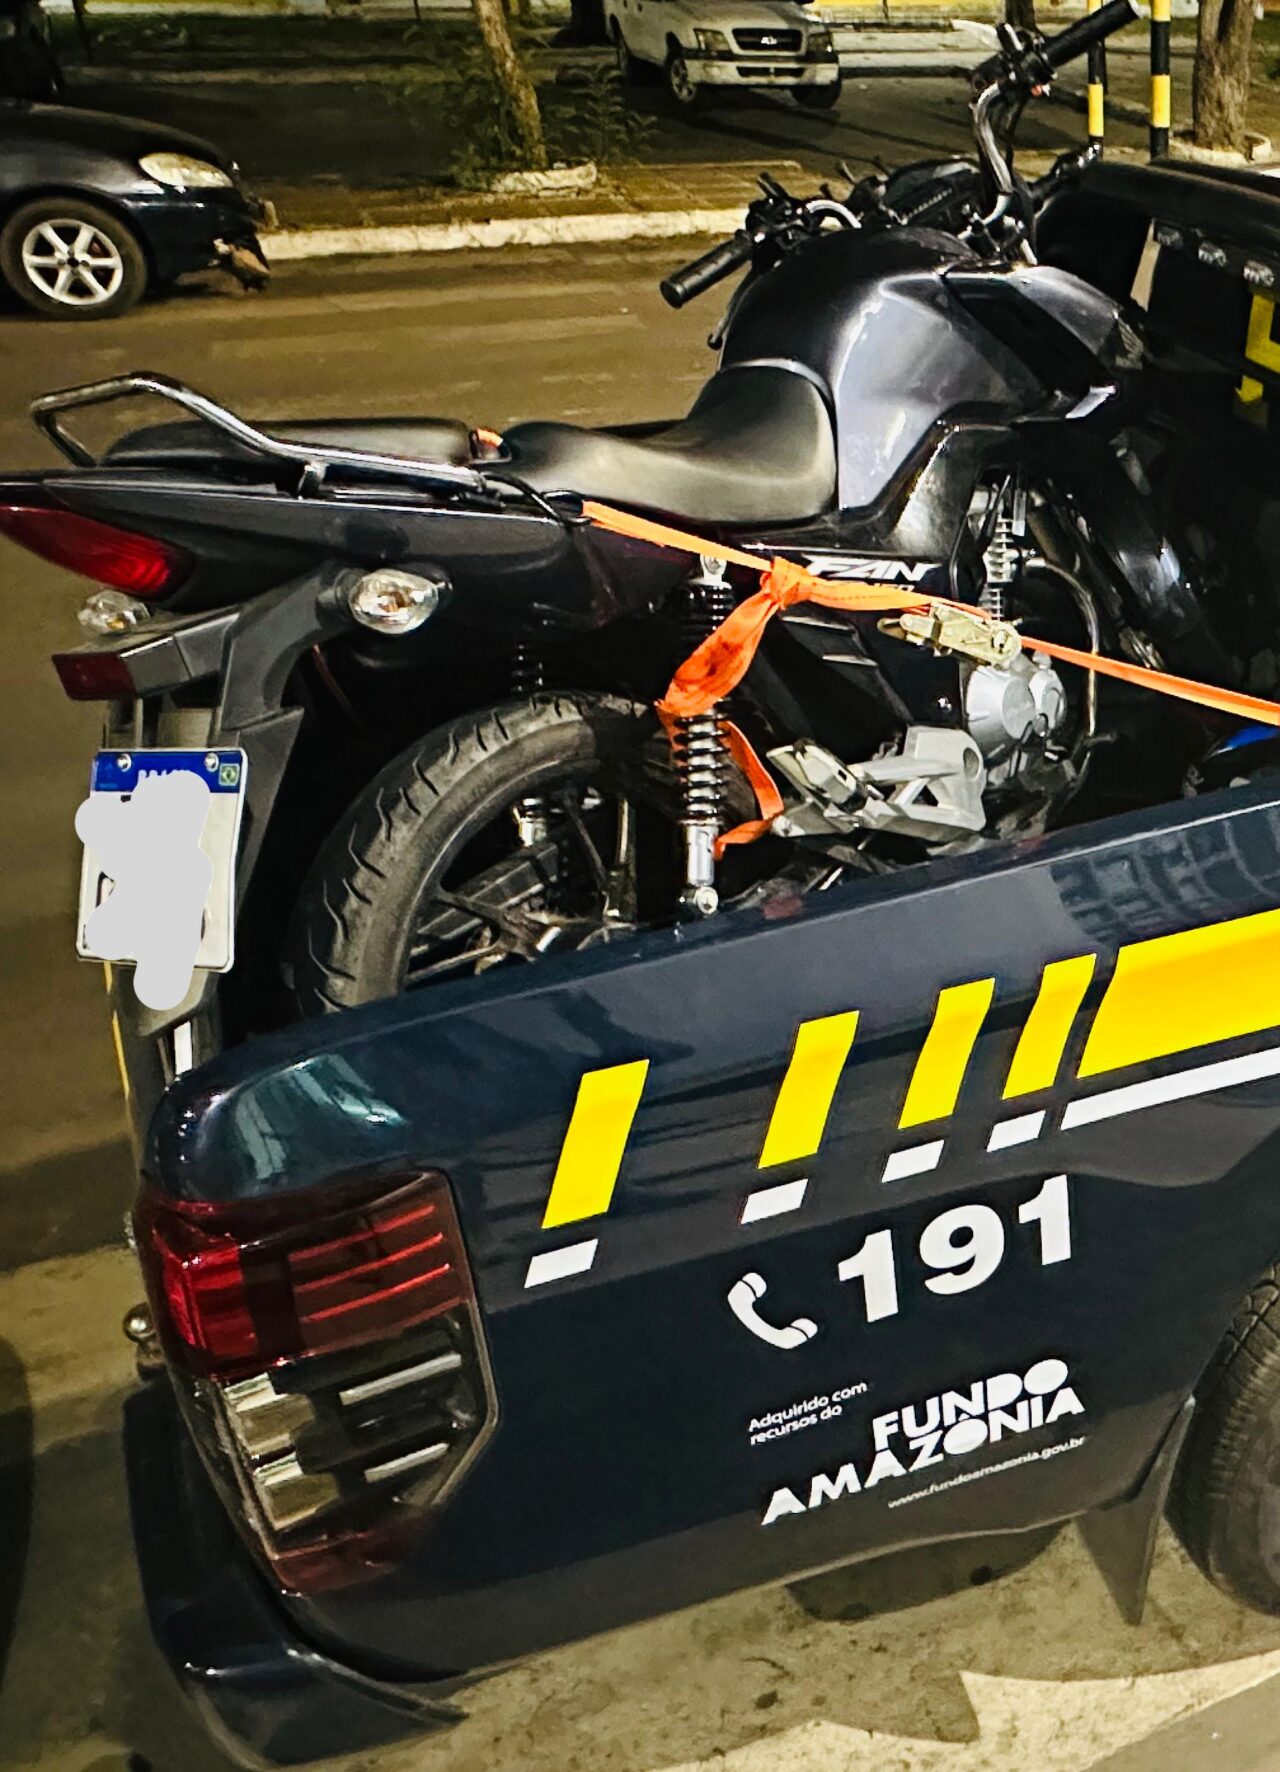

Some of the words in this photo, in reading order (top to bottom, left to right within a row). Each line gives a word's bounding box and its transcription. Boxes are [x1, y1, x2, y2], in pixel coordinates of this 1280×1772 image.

[801, 553, 943, 582] FAN
[837, 1174, 1072, 1323] 191
[747, 1394, 829, 1434] Adquirido
[832, 1381, 868, 1404] com
[749, 1413, 818, 1446] recursos
[816, 1403, 843, 1426] do
[872, 1358, 1069, 1452] FUNDO
